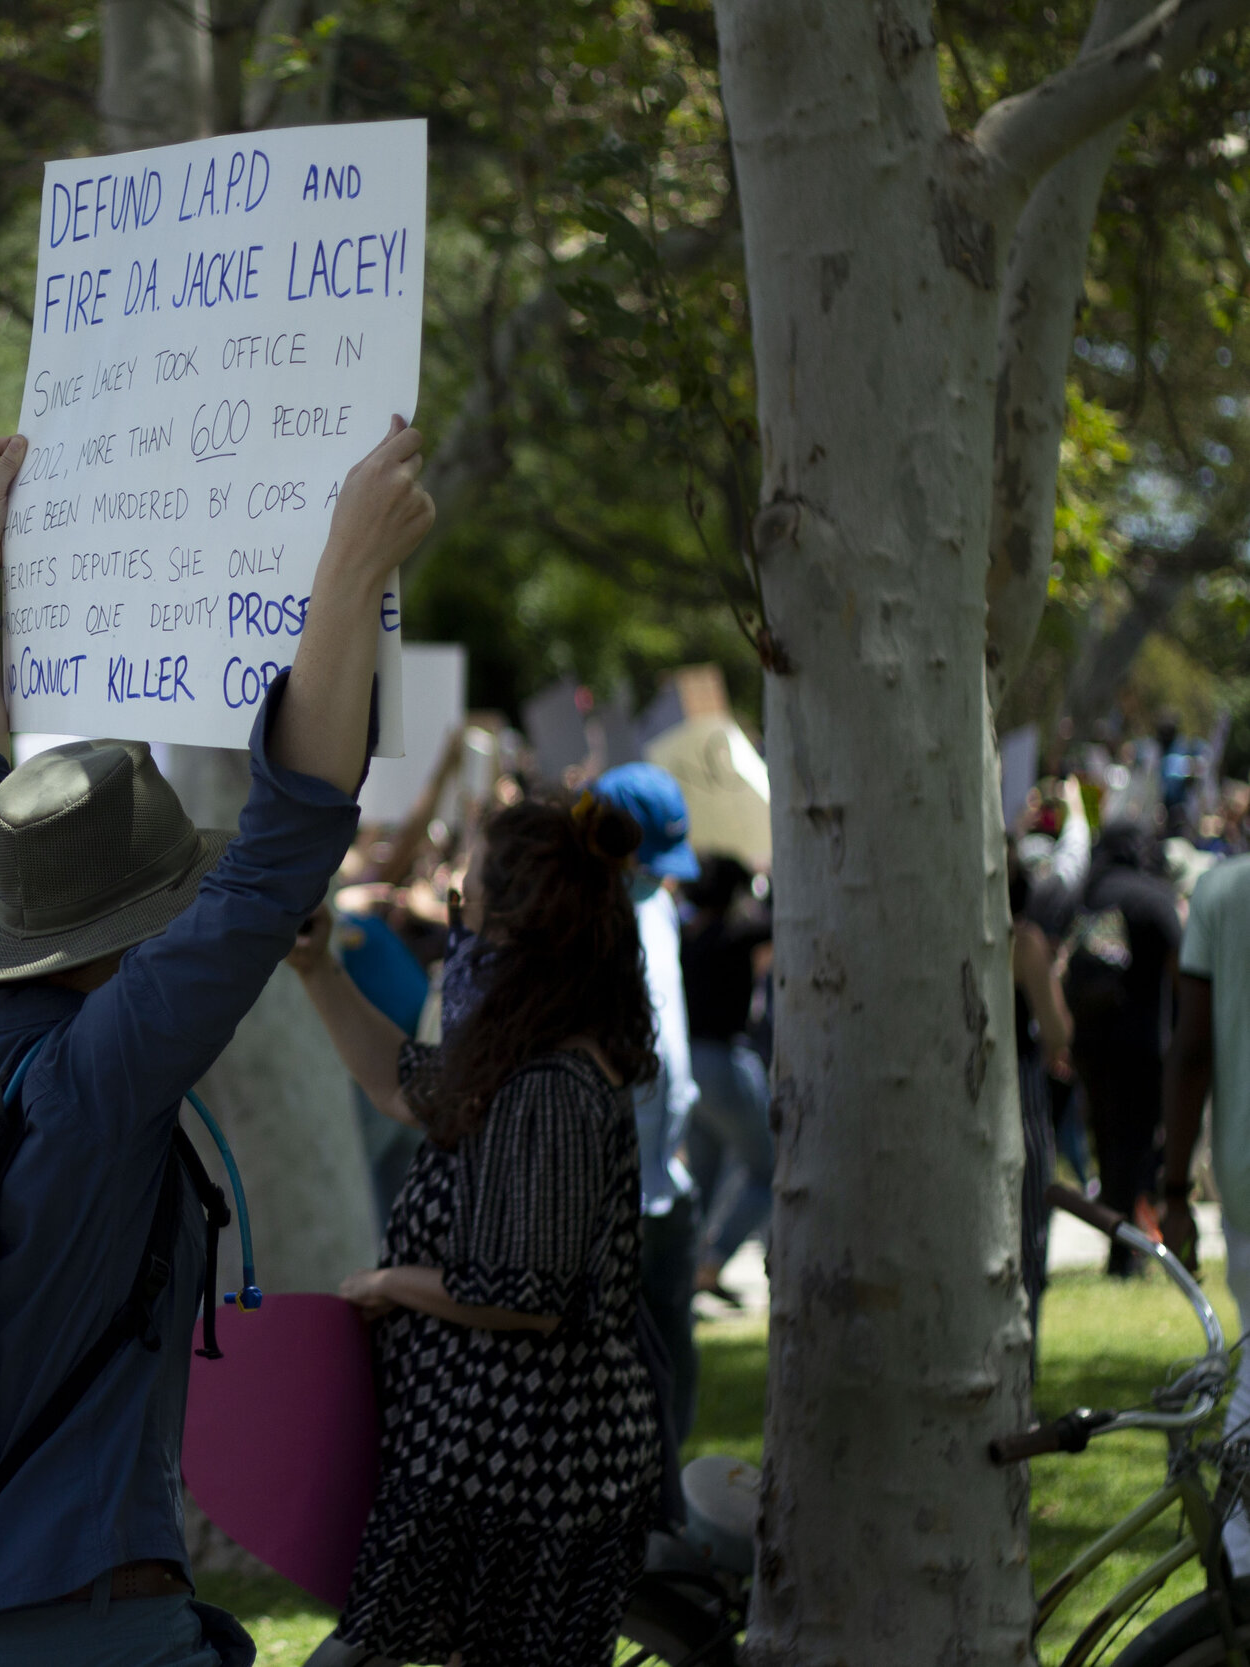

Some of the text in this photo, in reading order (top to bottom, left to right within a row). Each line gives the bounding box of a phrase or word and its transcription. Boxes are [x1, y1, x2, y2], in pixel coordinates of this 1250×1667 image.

[50, 167, 162, 248] DEFUND
[303, 164, 361, 201] AND
[43, 228, 407, 334] FIRE D.A. JACKIE LACEY!
[33, 333, 363, 418] SINCE LACEY TOOK OFFICE IN
[19, 399, 352, 486] 2012, MORE THAN 600 PEOPLE
[43, 494, 81, 531] BEEN
[92, 487, 188, 524] MURDERED
[209, 482, 231, 519] BY
[248, 481, 306, 519] COPS
[3, 544, 284, 592] HERIFF'S DEPUTIES. SHE ONLY
[4, 604, 70, 636] ROSECUTED
[86, 603, 125, 635] ONE
[21, 646, 87, 699] CONVICT
[107, 655, 195, 703] KILLER
[223, 656, 292, 708] COP
